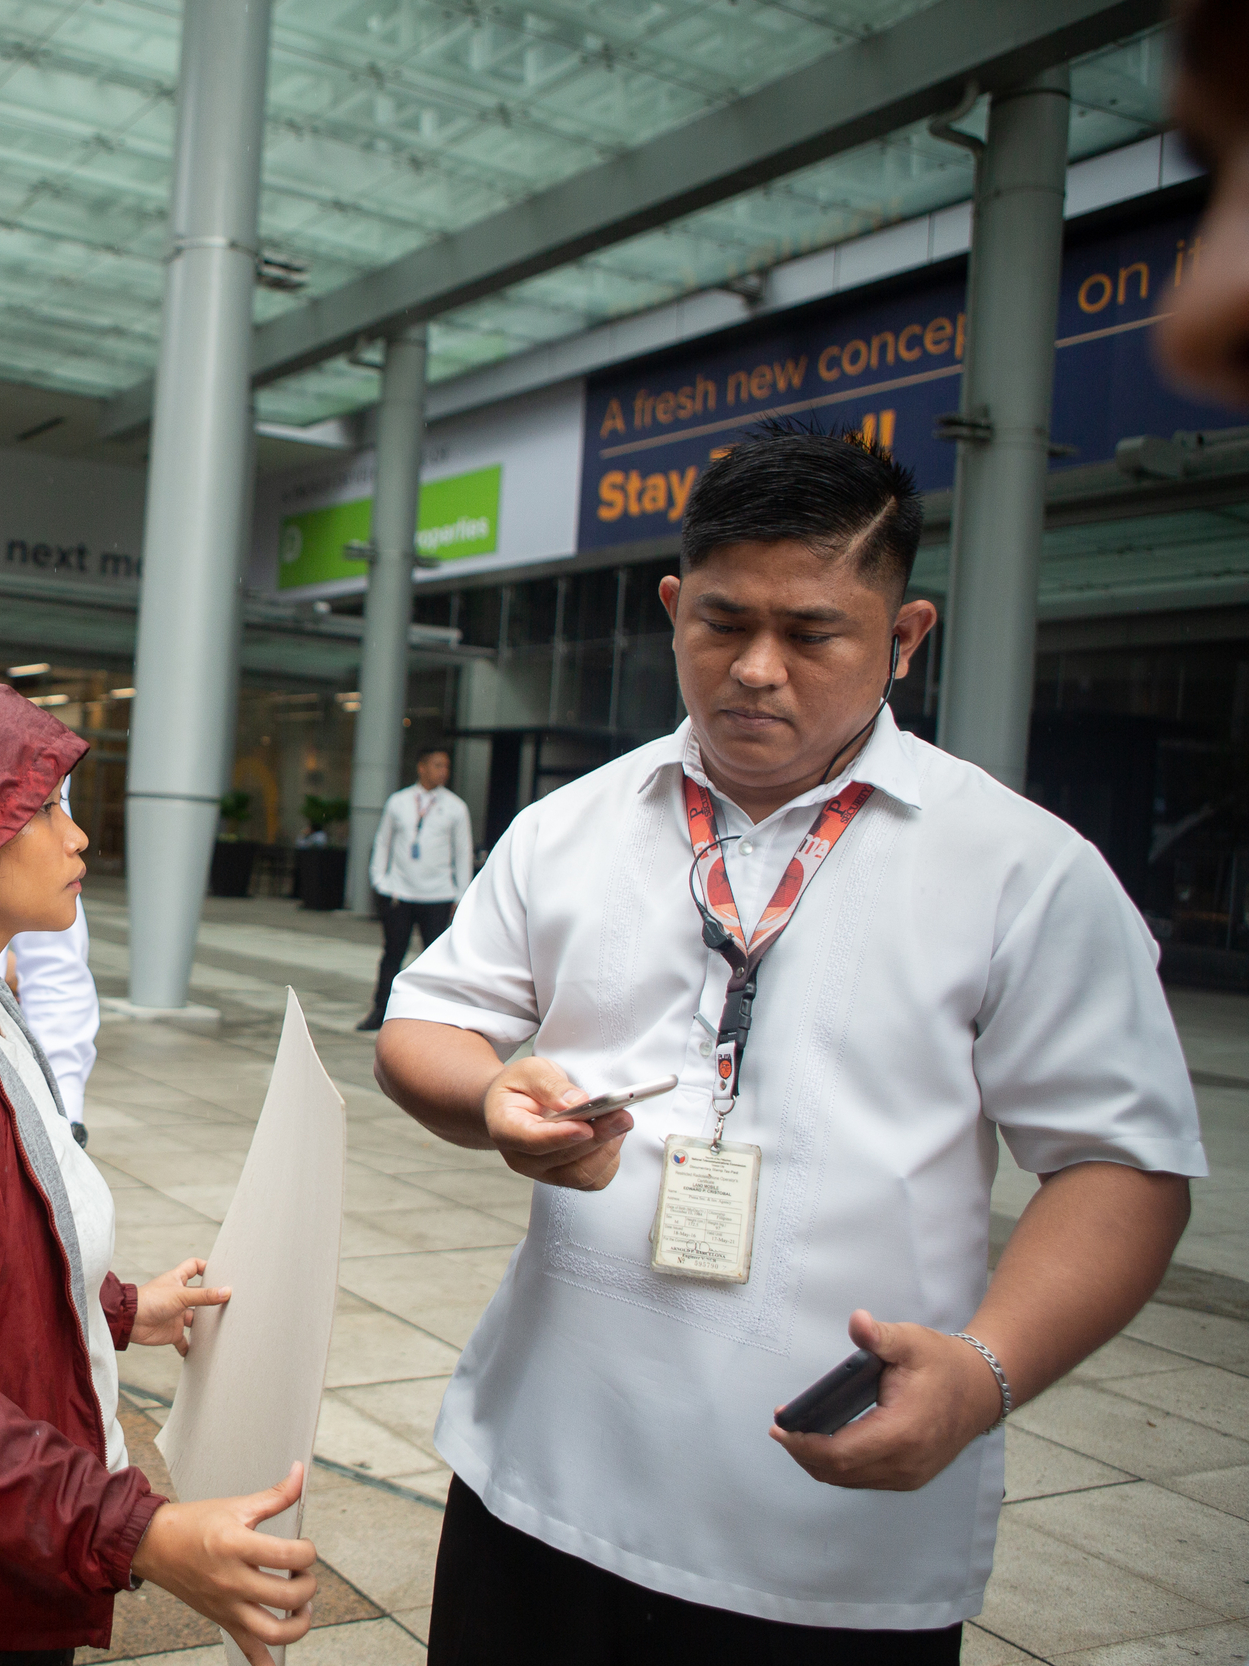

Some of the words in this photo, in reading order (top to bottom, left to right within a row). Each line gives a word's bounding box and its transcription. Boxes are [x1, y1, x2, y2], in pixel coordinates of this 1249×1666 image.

[600, 398, 626, 439] A
[633, 373, 717, 431] fresh
[726, 357, 808, 407] new
[1077, 261, 1150, 315] on
[597, 465, 698, 523] Stay
[6, 537, 88, 573] next
[826, 800, 847, 818] P
[840, 786, 871, 824] SECURITY
[694, 1260, 718, 1269] 595790
